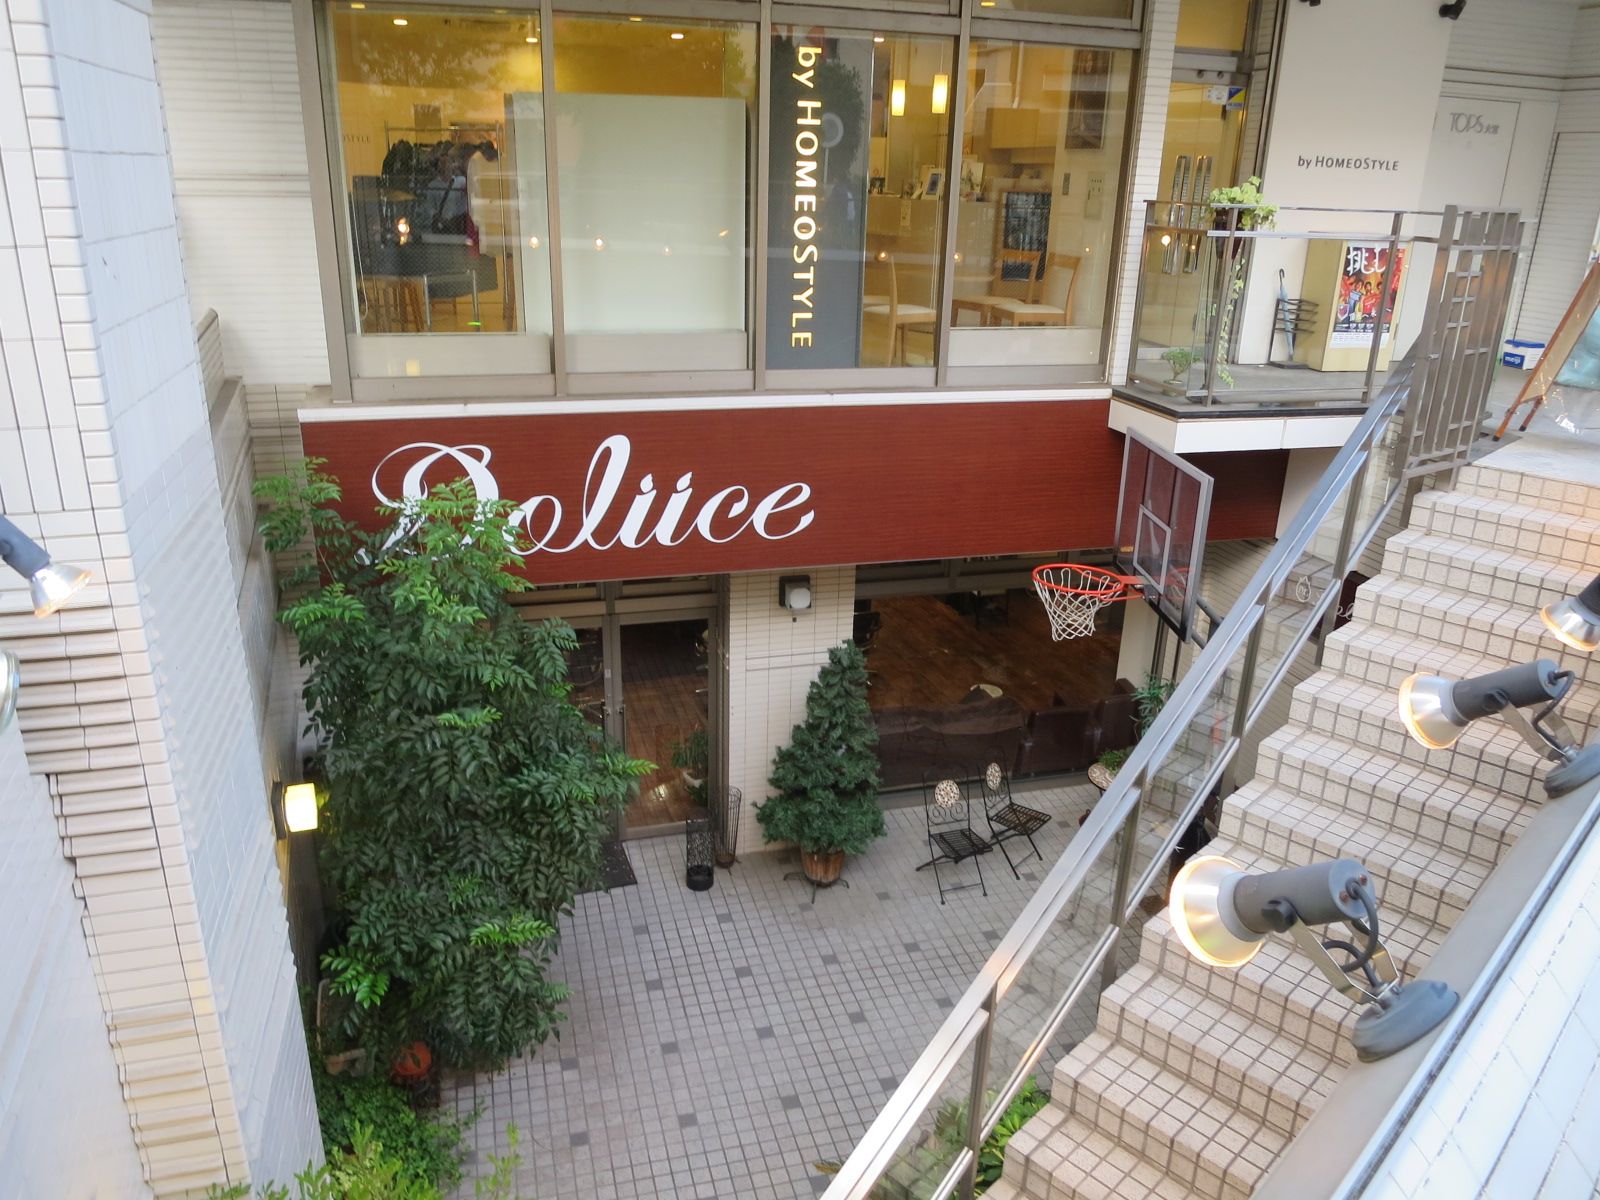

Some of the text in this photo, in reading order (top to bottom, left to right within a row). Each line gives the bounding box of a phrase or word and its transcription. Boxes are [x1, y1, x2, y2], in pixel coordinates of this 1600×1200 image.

[1449, 112, 1484, 134] TOPS
[1298, 155, 1399, 171] by HOMEOSTYLE
[791, 46, 822, 347] by HOMEOSTYLE
